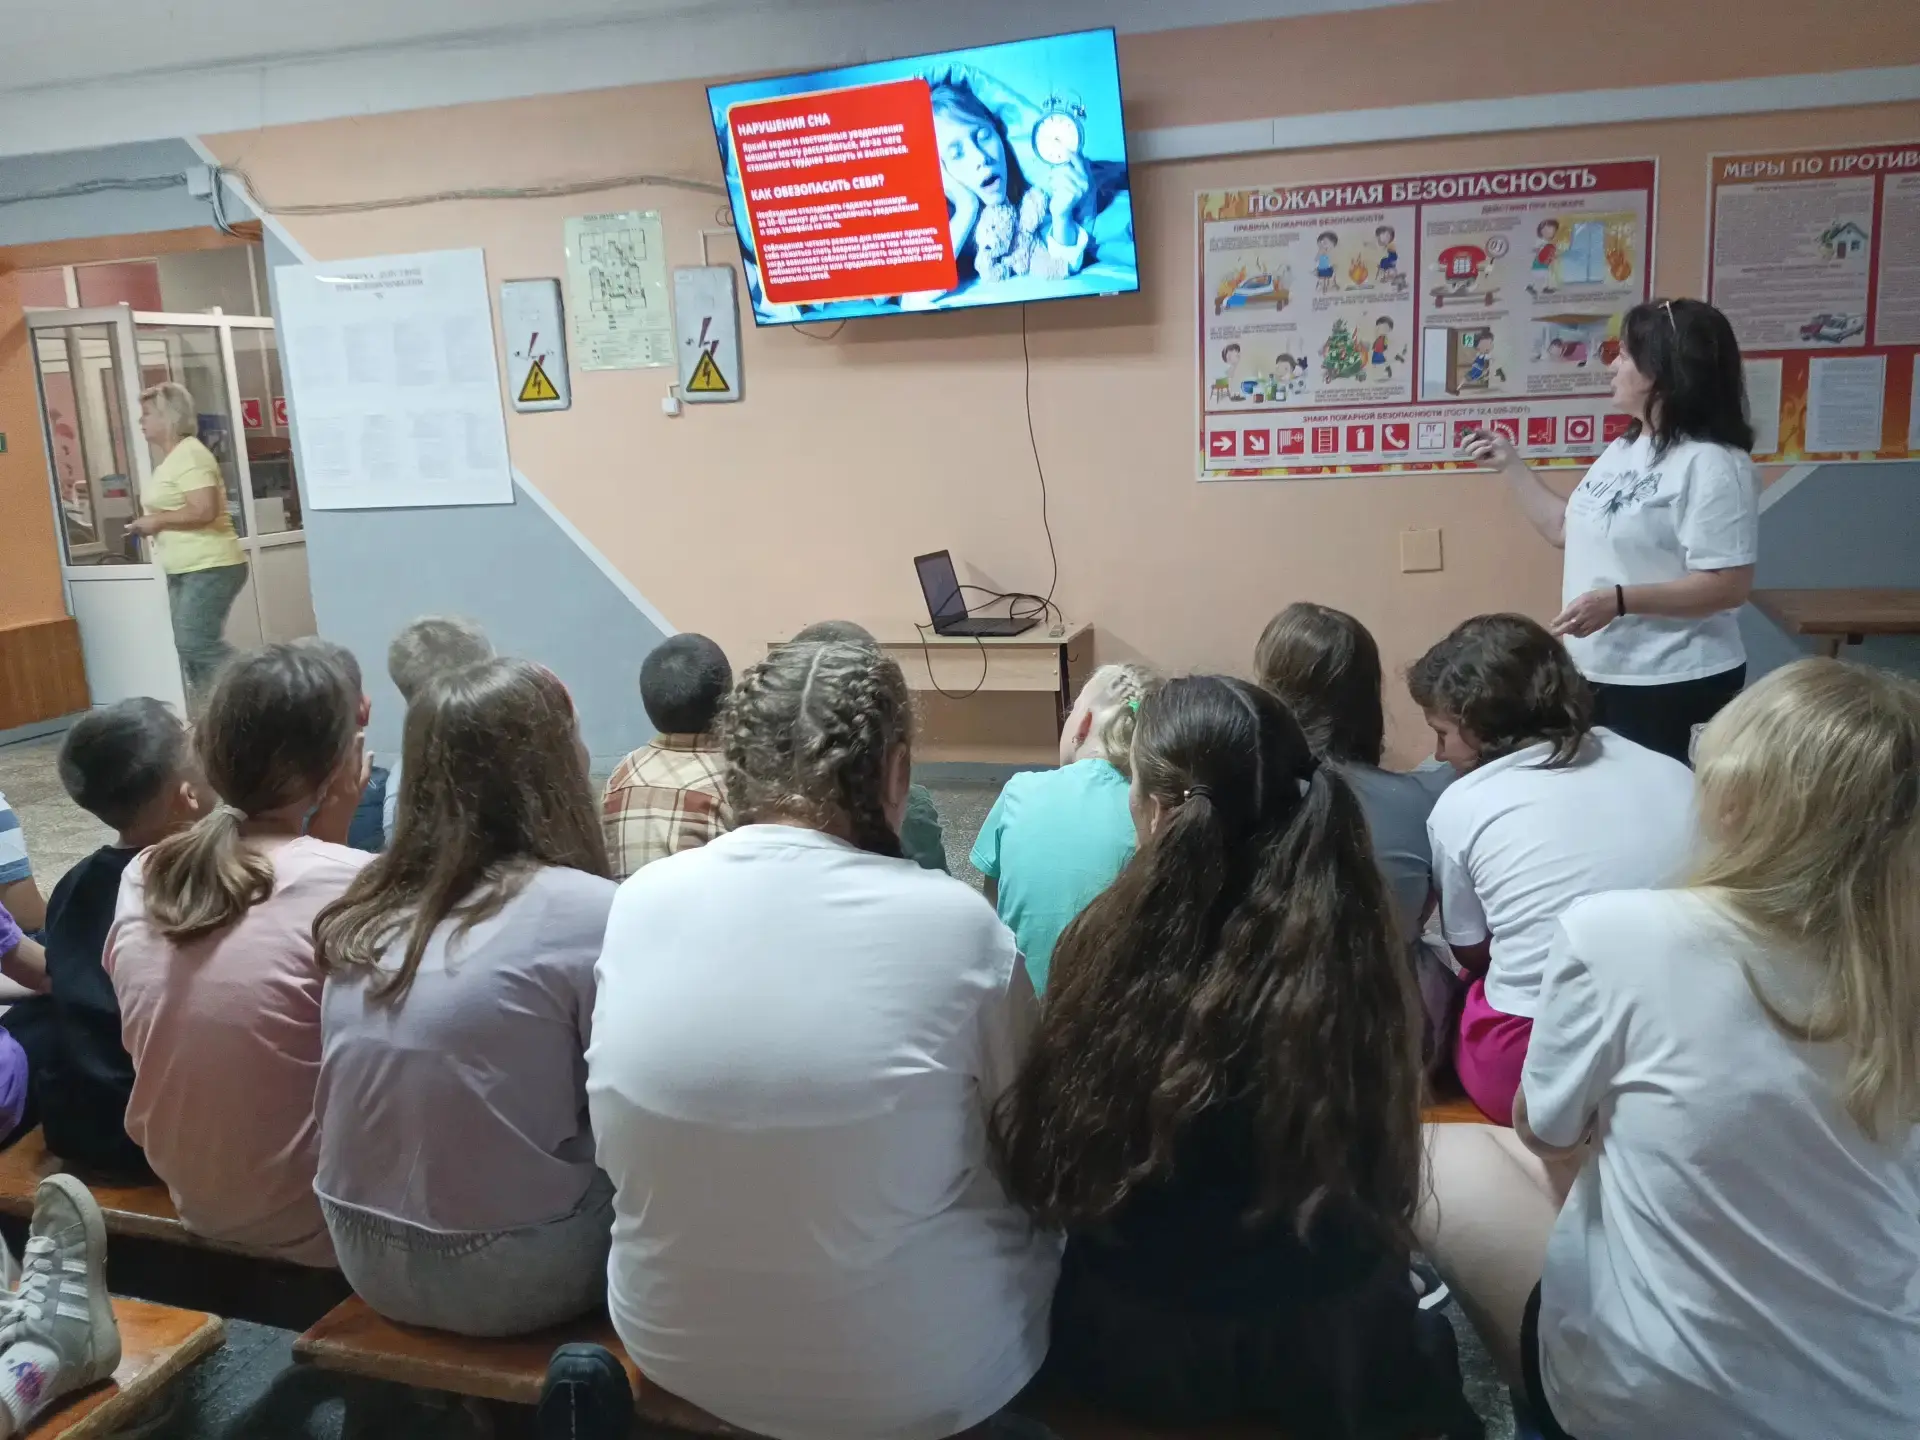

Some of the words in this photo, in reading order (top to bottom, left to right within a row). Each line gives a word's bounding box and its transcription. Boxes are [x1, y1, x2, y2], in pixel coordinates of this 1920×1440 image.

[738, 115, 806, 136] НАРУШЕНИЯ
[807, 112, 830, 126] СНА
[793, 138, 798, 146] и
[800, 132, 847, 145] постоянные
[848, 124, 904, 140] уведомления
[745, 150, 777, 162] мешают
[860, 138, 882, 148] из-за
[883, 135, 902, 144] чего
[746, 160, 790, 172] становится
[791, 156, 824, 169] труднее
[825, 152, 856, 163] заснуть
[857, 151, 863, 159] и
[1723, 159, 1785, 178] МЕРЫ
[1791, 157, 1823, 174] ПО
[1830, 151, 1920, 172] ПРОТИВ
[751, 188, 773, 201] КАК
[774, 178, 850, 199] ОБЕЗОПАСИТЬ
[852, 174, 884, 189] СЕБЯ?
[1248, 184, 1384, 214] ПОЖАРНАЯ
[1391, 168, 1598, 202] БЕЗОПАСНОСТЬ
[872, 203, 919, 217] уведомления
[1233, 223, 1270, 232] ПРАВИЛА
[1272, 219, 1318, 230] ПОЖАРНОЙ
[1319, 214, 1384, 227] БЕЗОПАСНОСТИ
[1302, 416, 1329, 424] ЗНАКИ
[1330, 412, 1376, 422] ПОЖАРНОЙ
[1376, 410, 1443, 421] БЕЗОПАСНОСТИ
